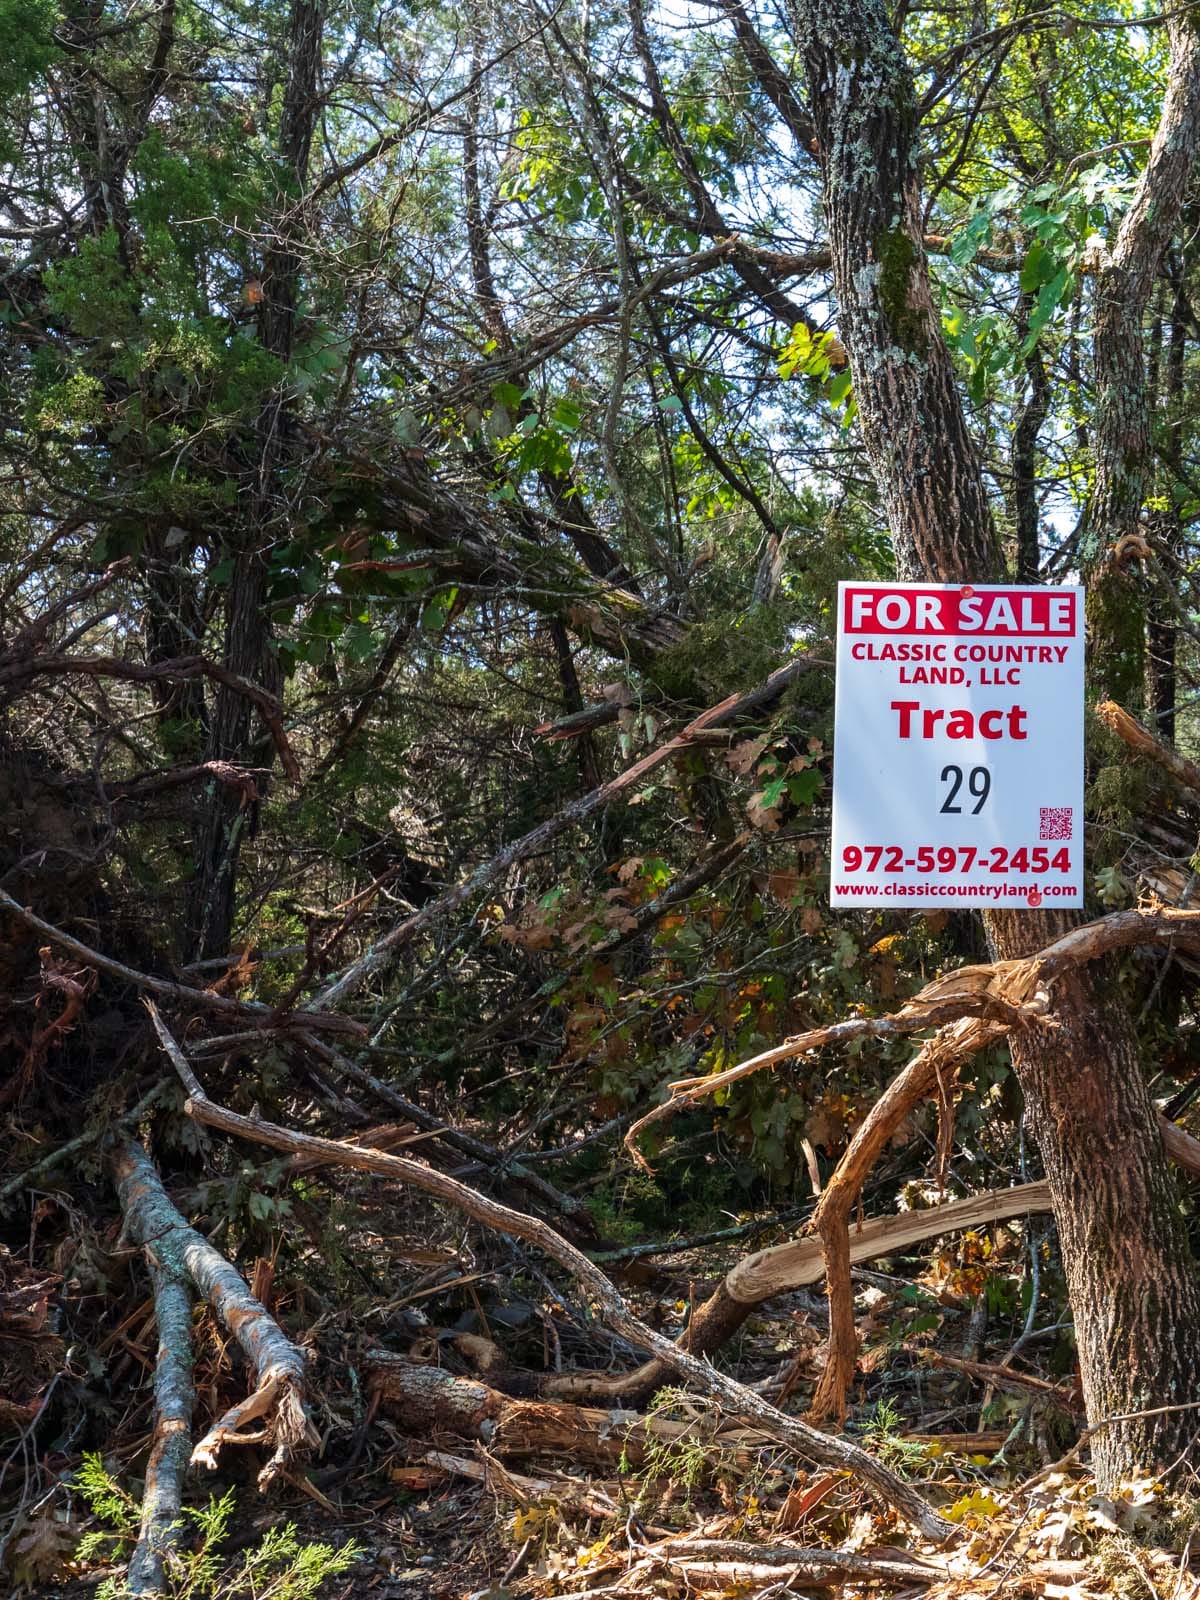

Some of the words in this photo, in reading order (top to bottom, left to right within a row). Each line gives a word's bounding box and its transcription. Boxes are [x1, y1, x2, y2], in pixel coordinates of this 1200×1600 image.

[851, 594, 945, 630] FOR
[958, 596, 1071, 632] SALE
[851, 642, 947, 662] CLASSIC
[953, 644, 1069, 664] COUNTRY
[899, 666, 972, 688] LAND,
[979, 667, 1021, 686] LLC
[890, 700, 1028, 741] Tract
[939, 764, 991, 815] 29
[842, 845, 1072, 874] 972-597-2454
[834, 882, 1077, 900] www.classiccountryland.com
